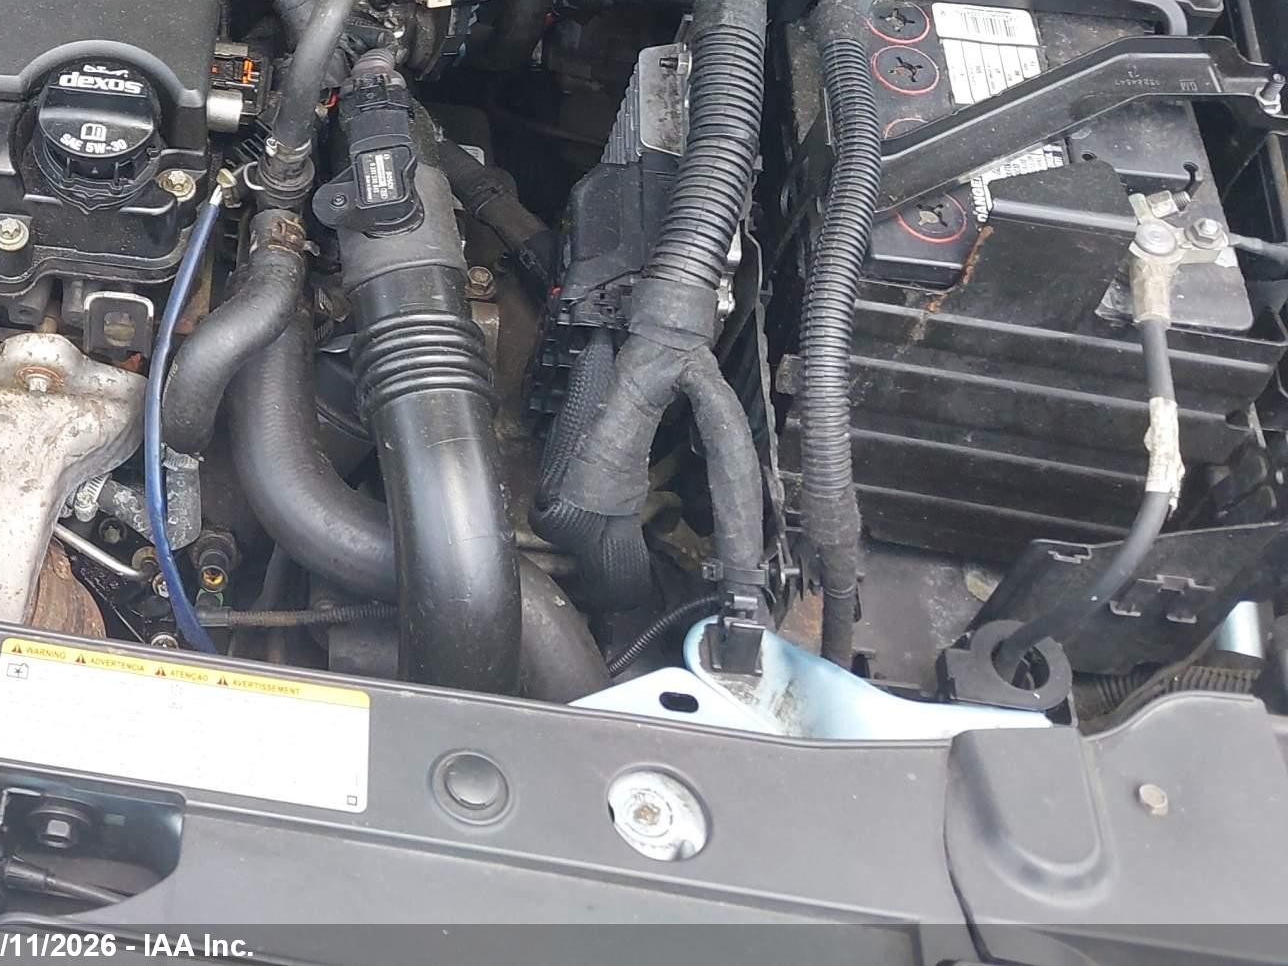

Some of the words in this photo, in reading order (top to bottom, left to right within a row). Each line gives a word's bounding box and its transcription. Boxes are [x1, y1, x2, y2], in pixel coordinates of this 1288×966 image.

[59, 71, 144, 94] dexos
[59, 133, 83, 151] SAE
[85, 138, 128, 154] 5W-30
[970, 176, 989, 222] DANGE
[25, 646, 66, 660] WARNING
[90, 657, 145, 672] ADVERTENCIA
[232, 679, 301, 696] AVERTISSEMENT
